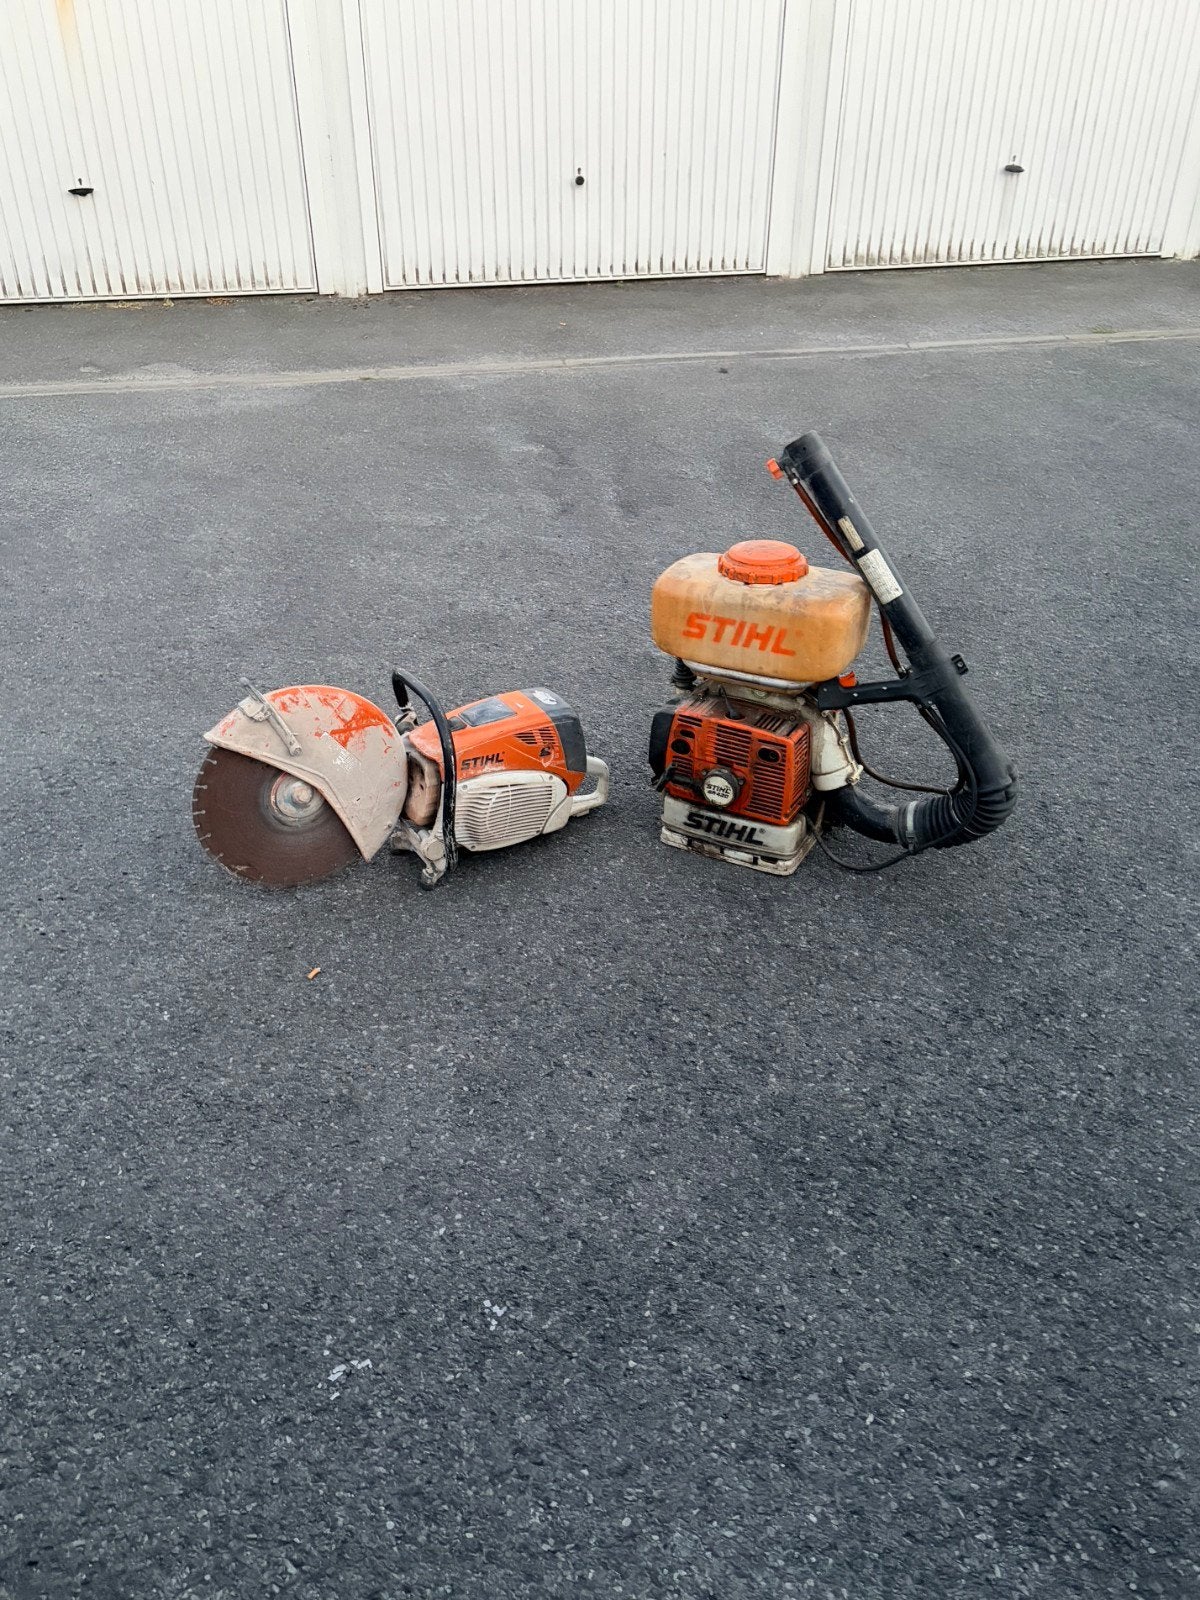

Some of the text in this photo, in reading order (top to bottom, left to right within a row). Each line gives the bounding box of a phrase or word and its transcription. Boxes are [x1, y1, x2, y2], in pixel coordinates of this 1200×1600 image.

[682, 611, 796, 657] STIHL
[460, 752, 504, 771] STIHL
[706, 783, 731, 794] STIHL
[684, 811, 764, 846] STIHL
